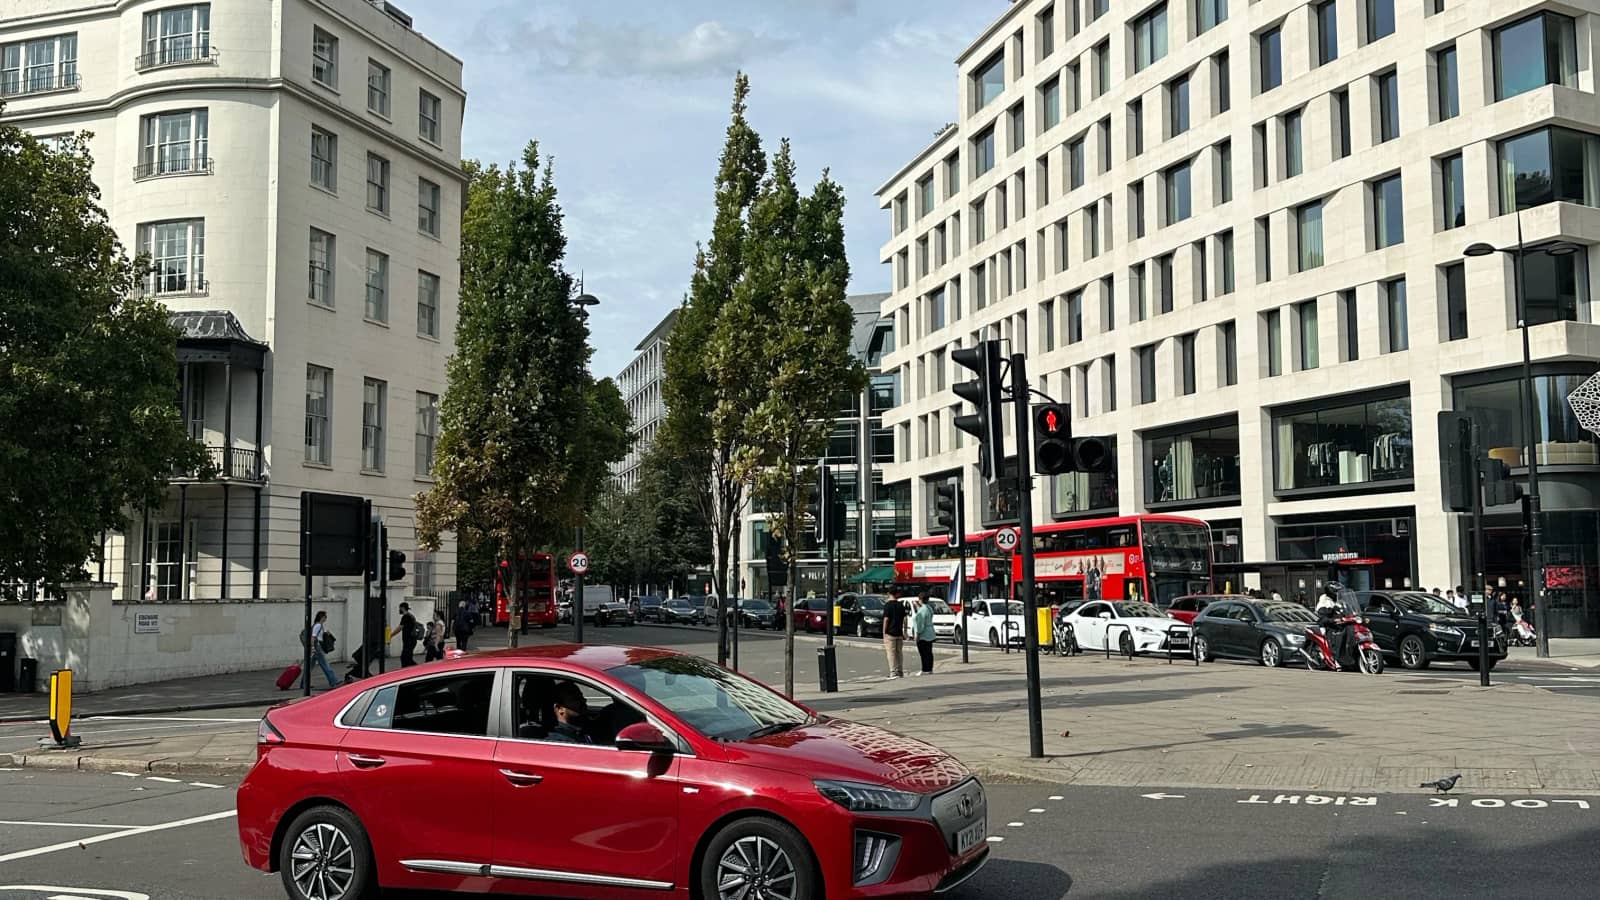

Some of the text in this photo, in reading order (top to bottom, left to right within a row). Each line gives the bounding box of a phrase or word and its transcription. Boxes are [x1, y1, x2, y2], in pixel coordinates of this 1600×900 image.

[998, 533, 1014, 545] 20
[573, 558, 586, 568] 20
[1191, 561, 1202, 571] 23
[1237, 794, 1591, 809] LOOK RIGHT
